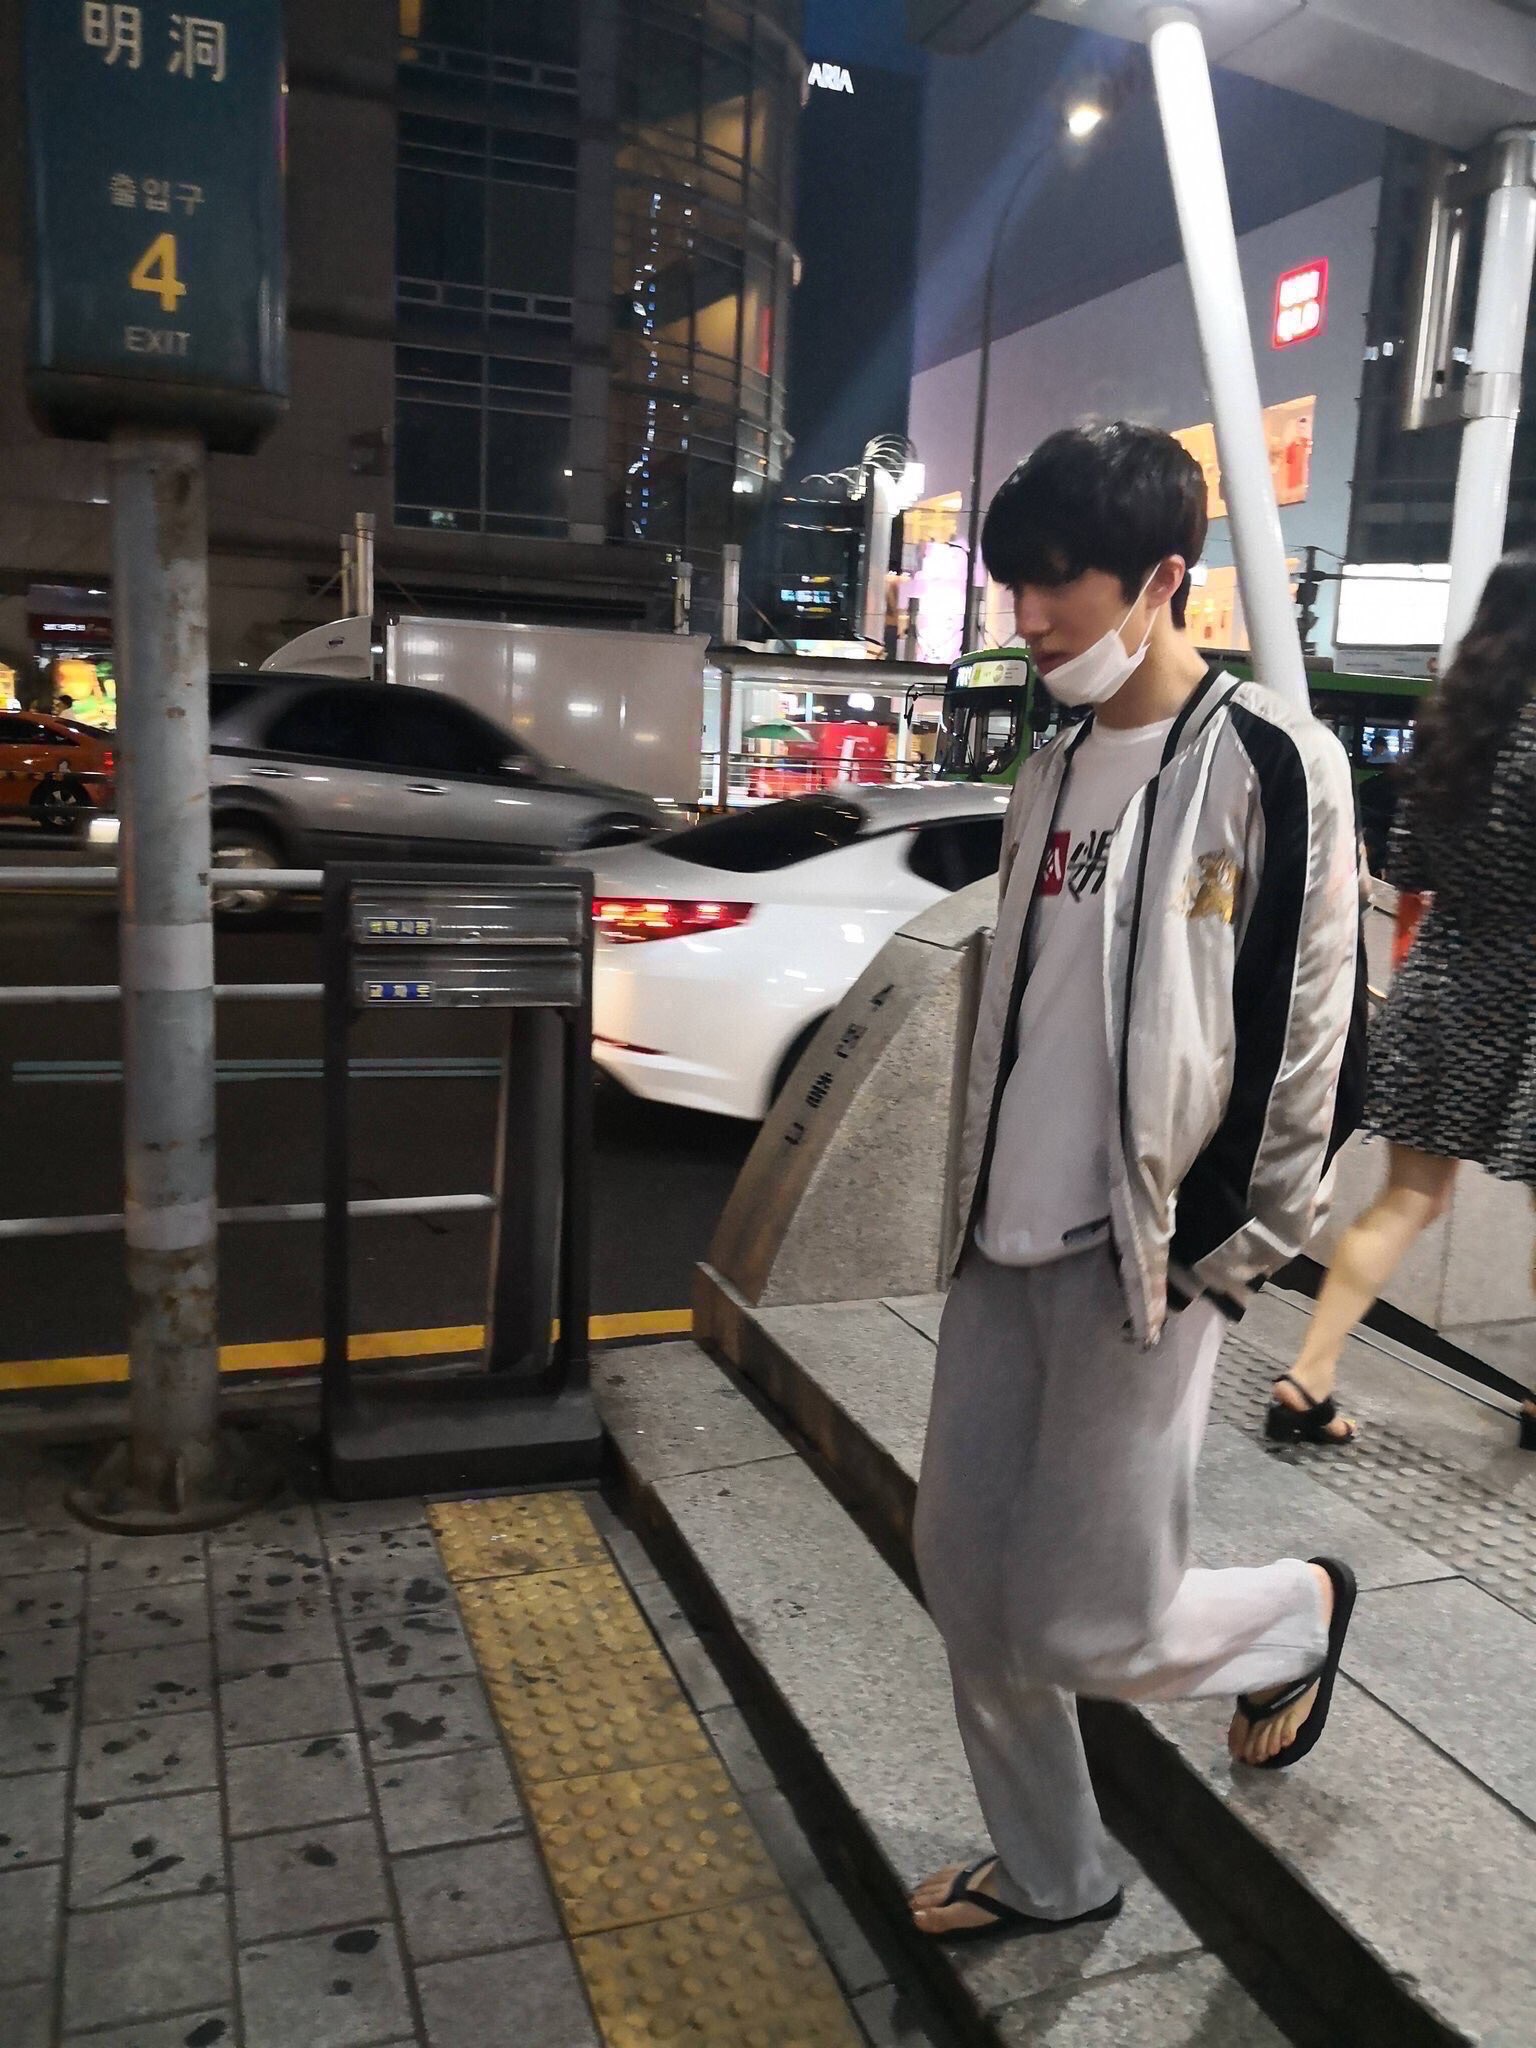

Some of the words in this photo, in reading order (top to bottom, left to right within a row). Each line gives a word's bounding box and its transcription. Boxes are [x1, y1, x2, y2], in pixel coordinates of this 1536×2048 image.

[83, 1, 226, 82] 明洞
[110, 171, 205, 216] 출입구
[129, 232, 187, 313] 4
[123, 325, 191, 356] EXIT
